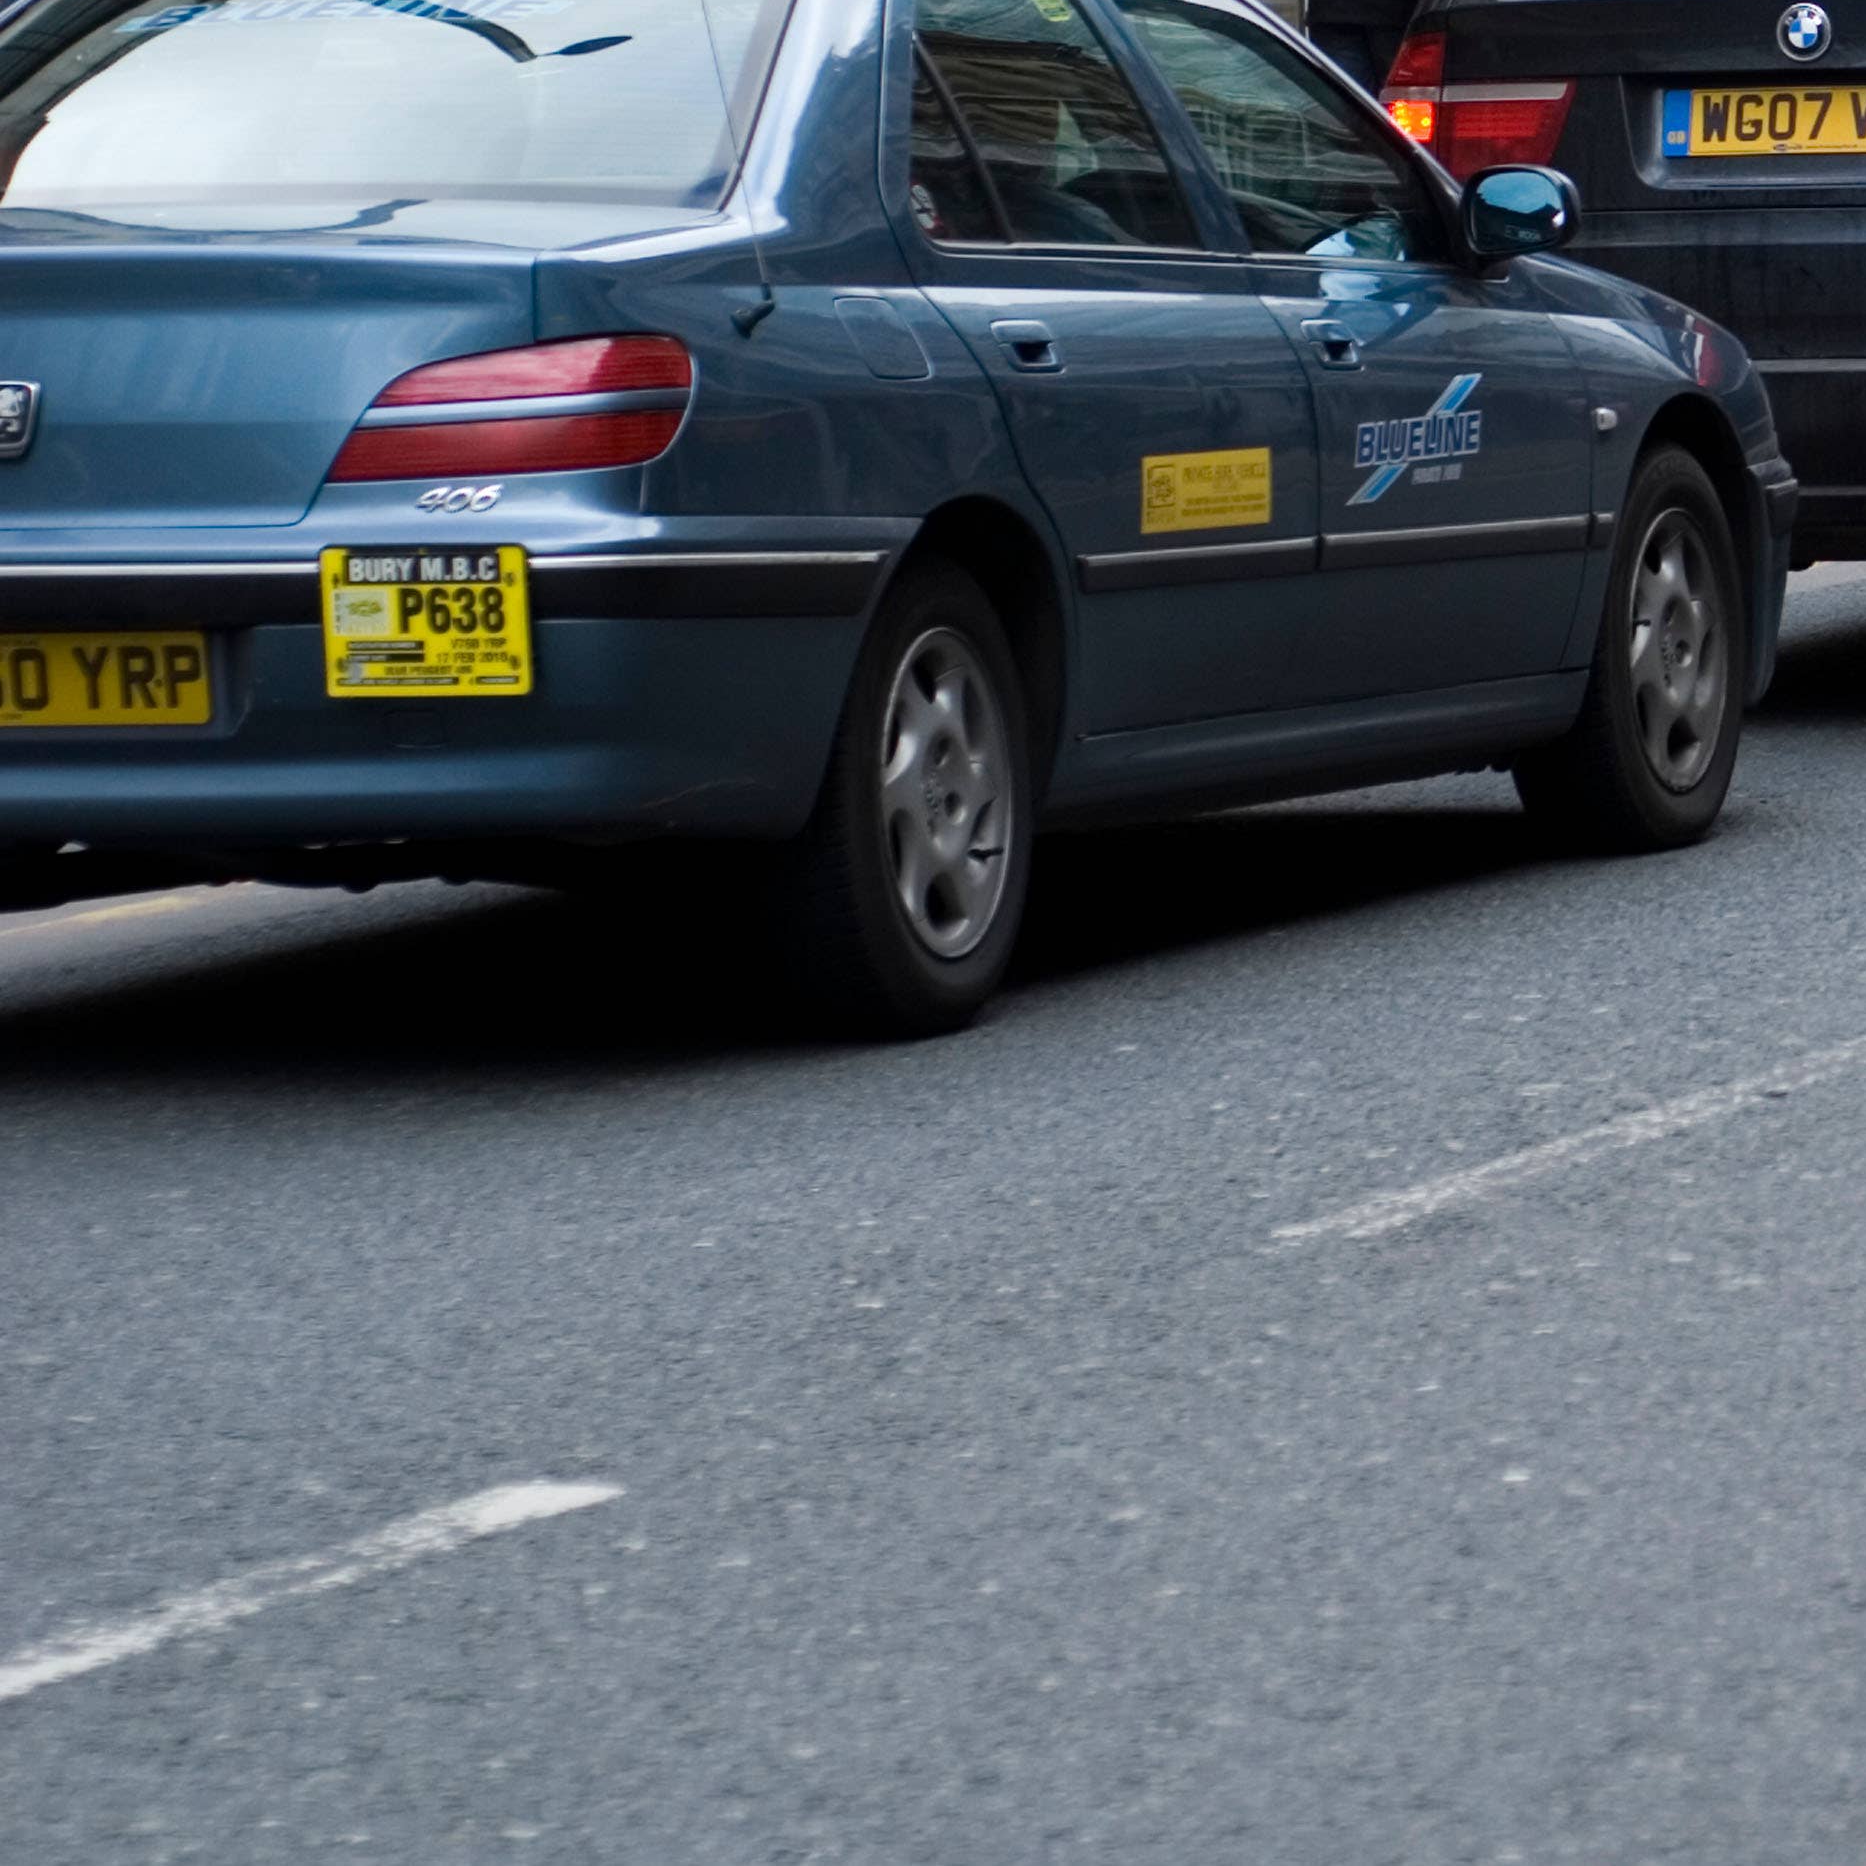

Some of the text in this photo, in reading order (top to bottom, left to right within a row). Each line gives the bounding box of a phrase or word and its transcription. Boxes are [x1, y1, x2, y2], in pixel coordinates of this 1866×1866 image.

[1703, 92, 1832, 143] WG07
[1354, 410, 1481, 467] BLUELINE
[416, 484, 504, 514] 406
[350, 556, 497, 582] BURY M.B.C
[398, 587, 505, 634] P638
[71, 645, 201, 710] YRP
